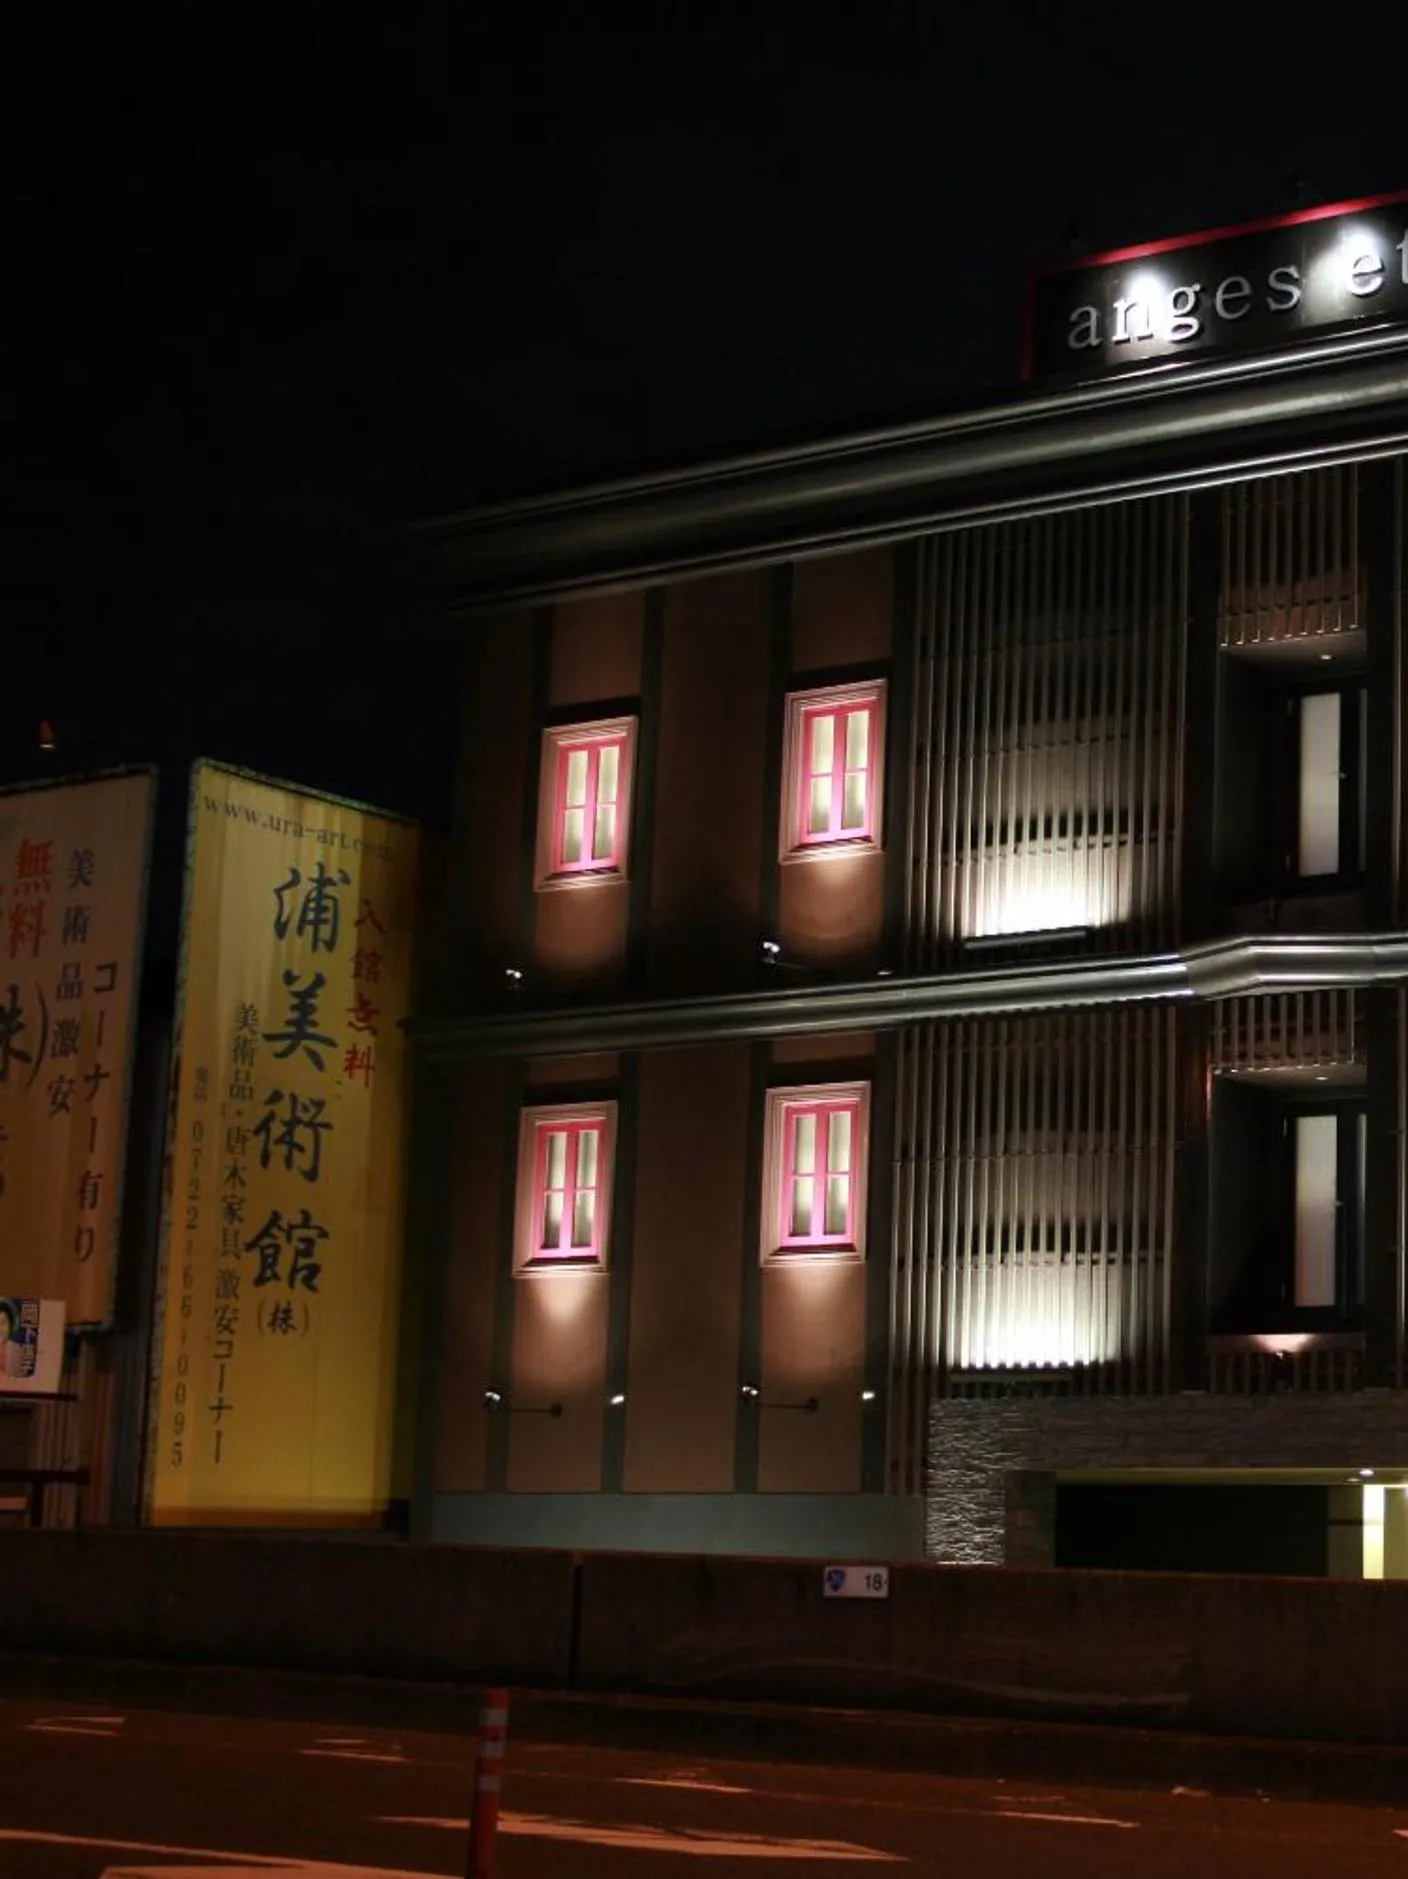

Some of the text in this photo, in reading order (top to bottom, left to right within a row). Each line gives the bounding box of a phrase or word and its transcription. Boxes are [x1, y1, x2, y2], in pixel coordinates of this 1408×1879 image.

[1067, 264, 1302, 350] anges
[49, 849, 95, 1118] 美術品激安
[244, 861, 352, 1292] 浦美術館
